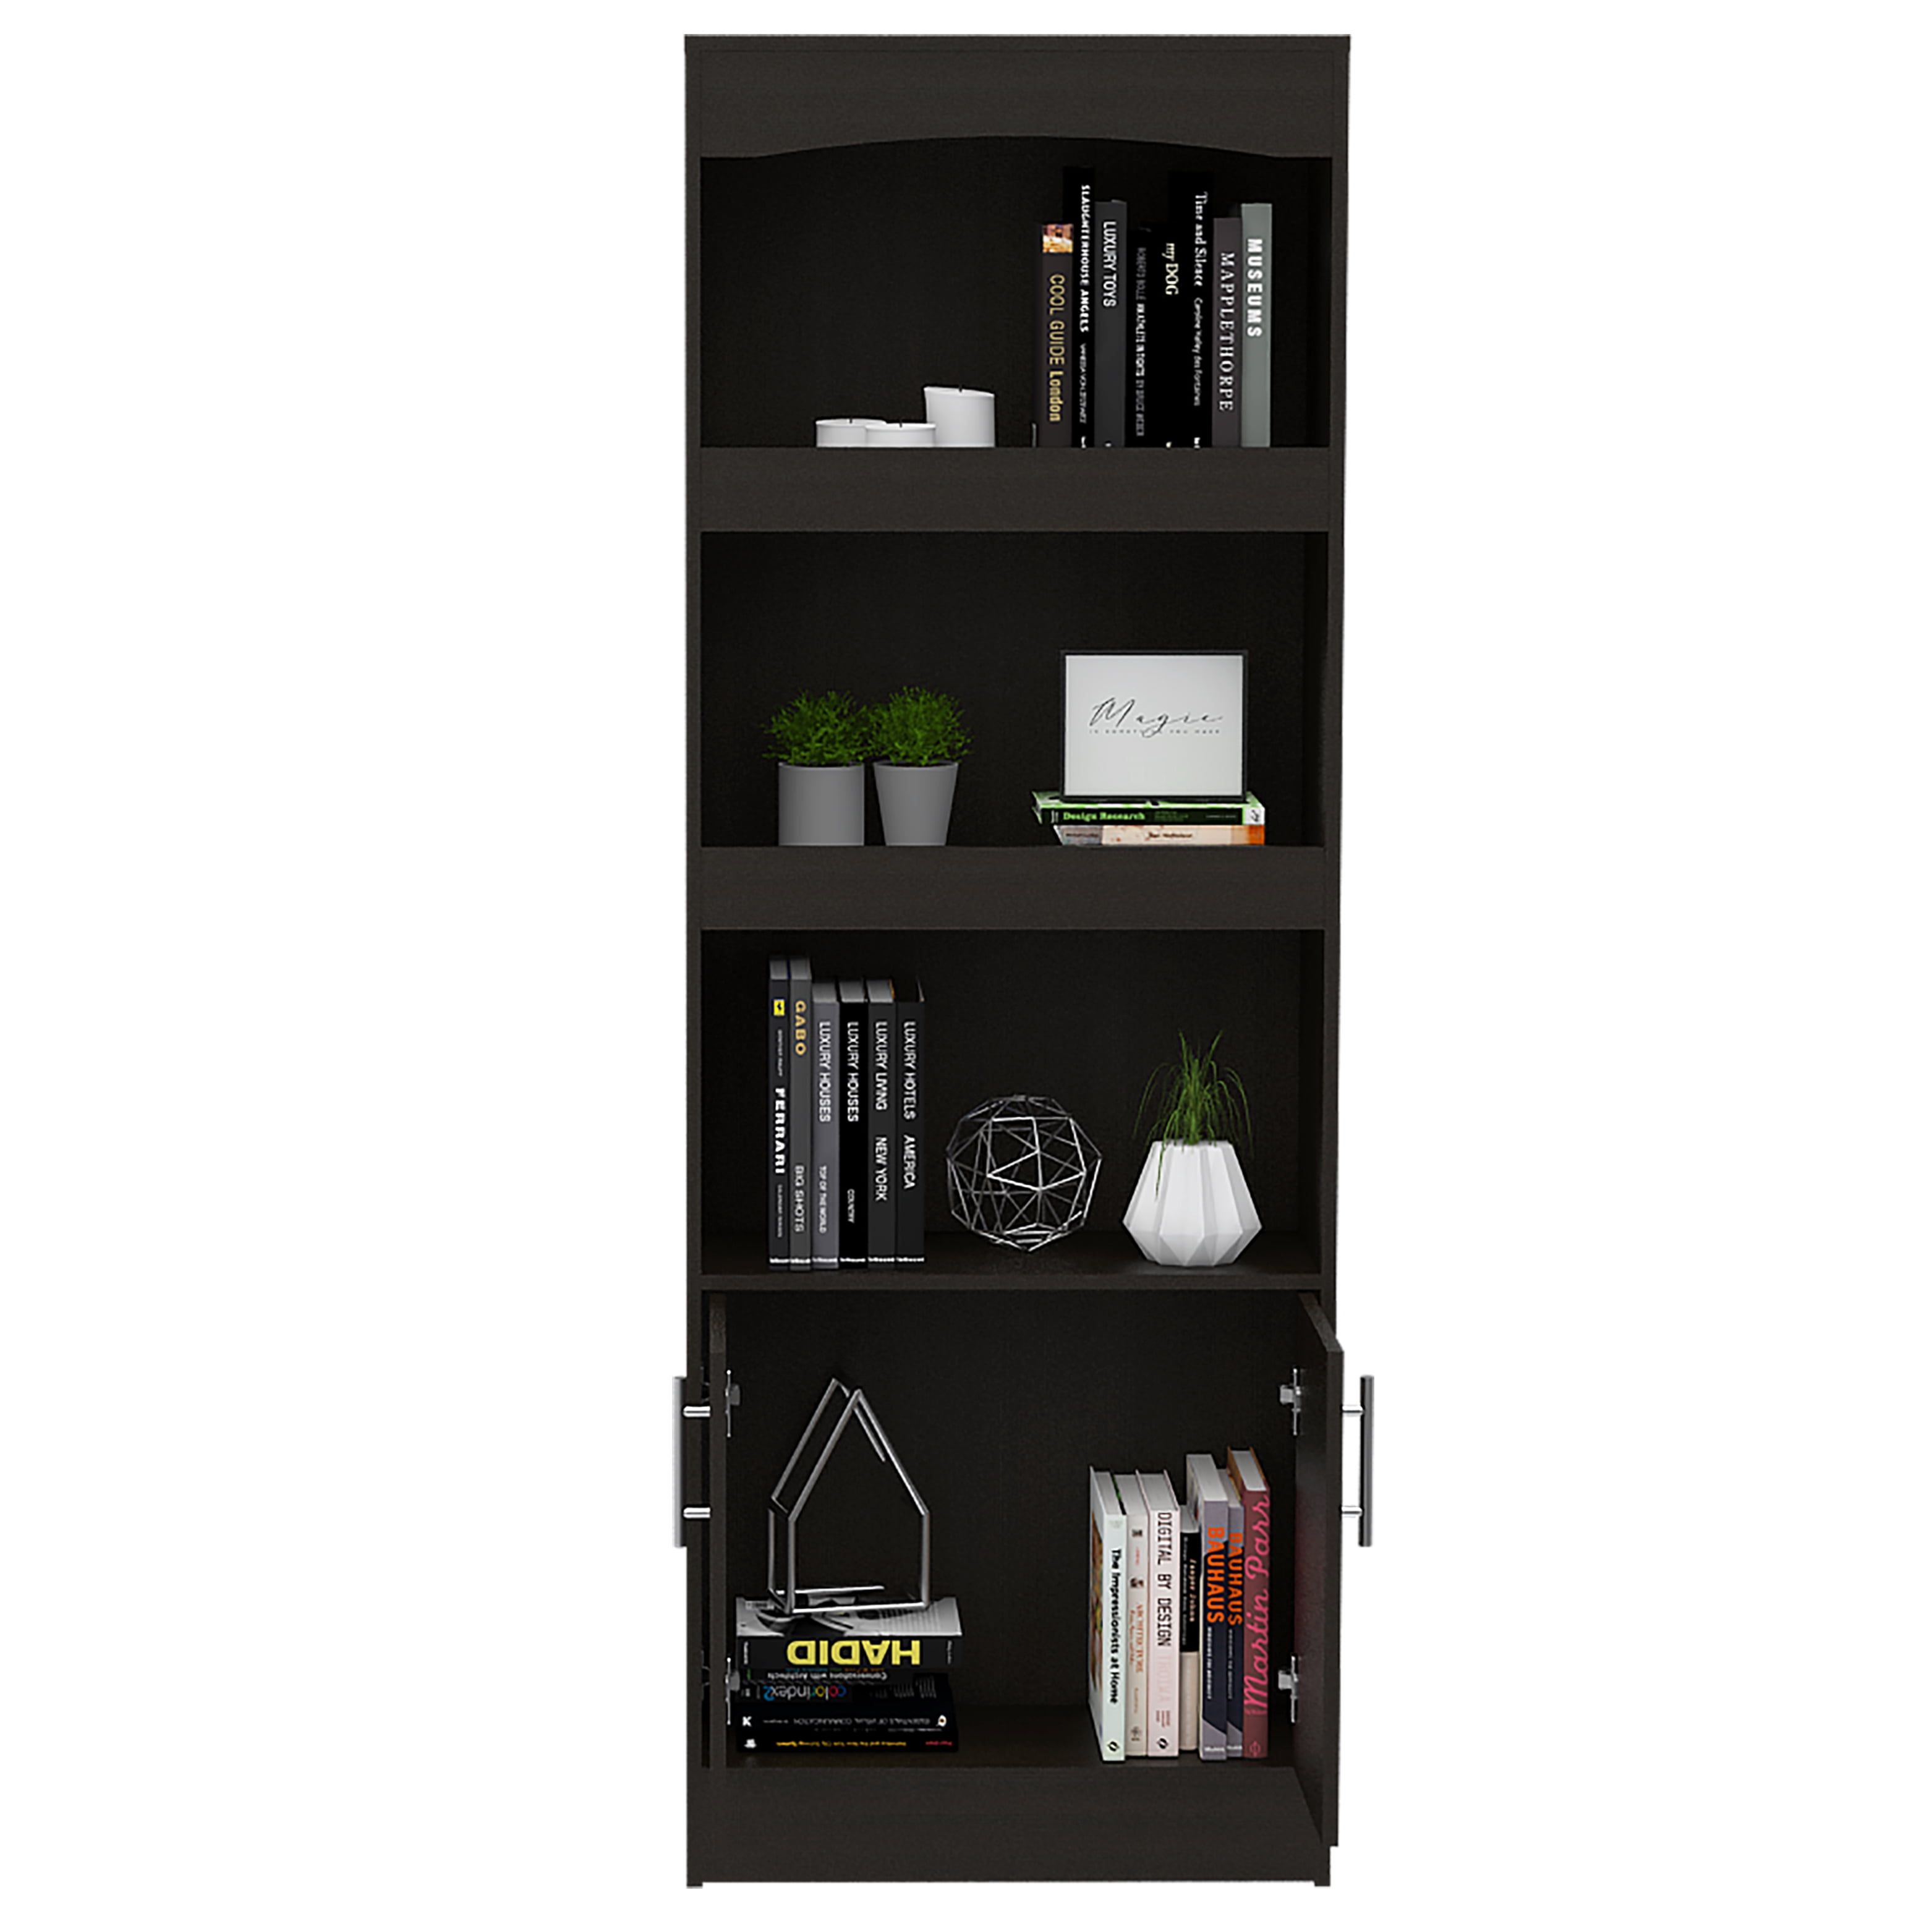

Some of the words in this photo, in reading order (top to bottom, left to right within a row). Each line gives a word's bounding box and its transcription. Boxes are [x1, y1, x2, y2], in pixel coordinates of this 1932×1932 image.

[1194, 192, 1207, 221] Time
[1079, 185, 1090, 286] SLAUGHTERHOUSE
[1103, 221, 1117, 270] LUXURY
[1162, 243, 1177, 261] my
[1194, 224, 1206, 244] and
[1165, 263, 1180, 295] DOG
[1194, 247, 1206, 286] Silence
[1247, 238, 1263, 338] MUSEUMS
[1049, 274, 1065, 315] COOL
[1079, 289, 1089, 332] ANGELS
[1103, 274, 1117, 307] TOYS
[1049, 321, 1065, 365] GUIDE
[1219, 252, 1235, 412] MAPPLETHORPE
[1049, 370, 1064, 422] London
[1063, 812, 1097, 823] Design
[1099, 812, 1145, 821] Research
[795, 1000, 806, 1055] GABO
[819, 1021, 831, 1068] LUXURY
[847, 1021, 859, 1068] LUXURY
[875, 1021, 887, 1068] LUXURY
[904, 1021, 916, 1068] LUXURY
[819, 1073, 831, 1122] HOUSES
[847, 1073, 859, 1122] HOUSES
[875, 1073, 887, 1110] LIVING
[904, 1072, 916, 1120] HOTELS
[775, 1087, 785, 1174] FERRARI
[875, 1137, 887, 1164] NEW
[794, 1165, 804, 1186] BIG
[875, 1167, 887, 1201] YORK
[904, 1135, 916, 1189] AMERICA
[794, 1190, 804, 1232] SHOTS
[819, 1207, 827, 1233] WORLD
[1110, 1549, 1121, 1569] The
[1157, 1512, 1172, 1565] DIGITAL
[1245, 1496, 1270, 1579] Parr
[1157, 1574, 1171, 1589] BY
[1207, 1527, 1225, 1623] BAUHAUS
[1228, 1532, 1243, 1625] BAUHAUS
[1109, 1572, 1121, 1653] Impressionists
[1157, 1598, 1171, 1646] DESIGN
[786, 1640, 921, 1665] HADID
[1109, 1657, 1120, 1669] at
[1244, 1589, 1269, 1709] Martin
[763, 1685, 847, 1701] colorindex2
[1109, 1672, 1120, 1704] Home
